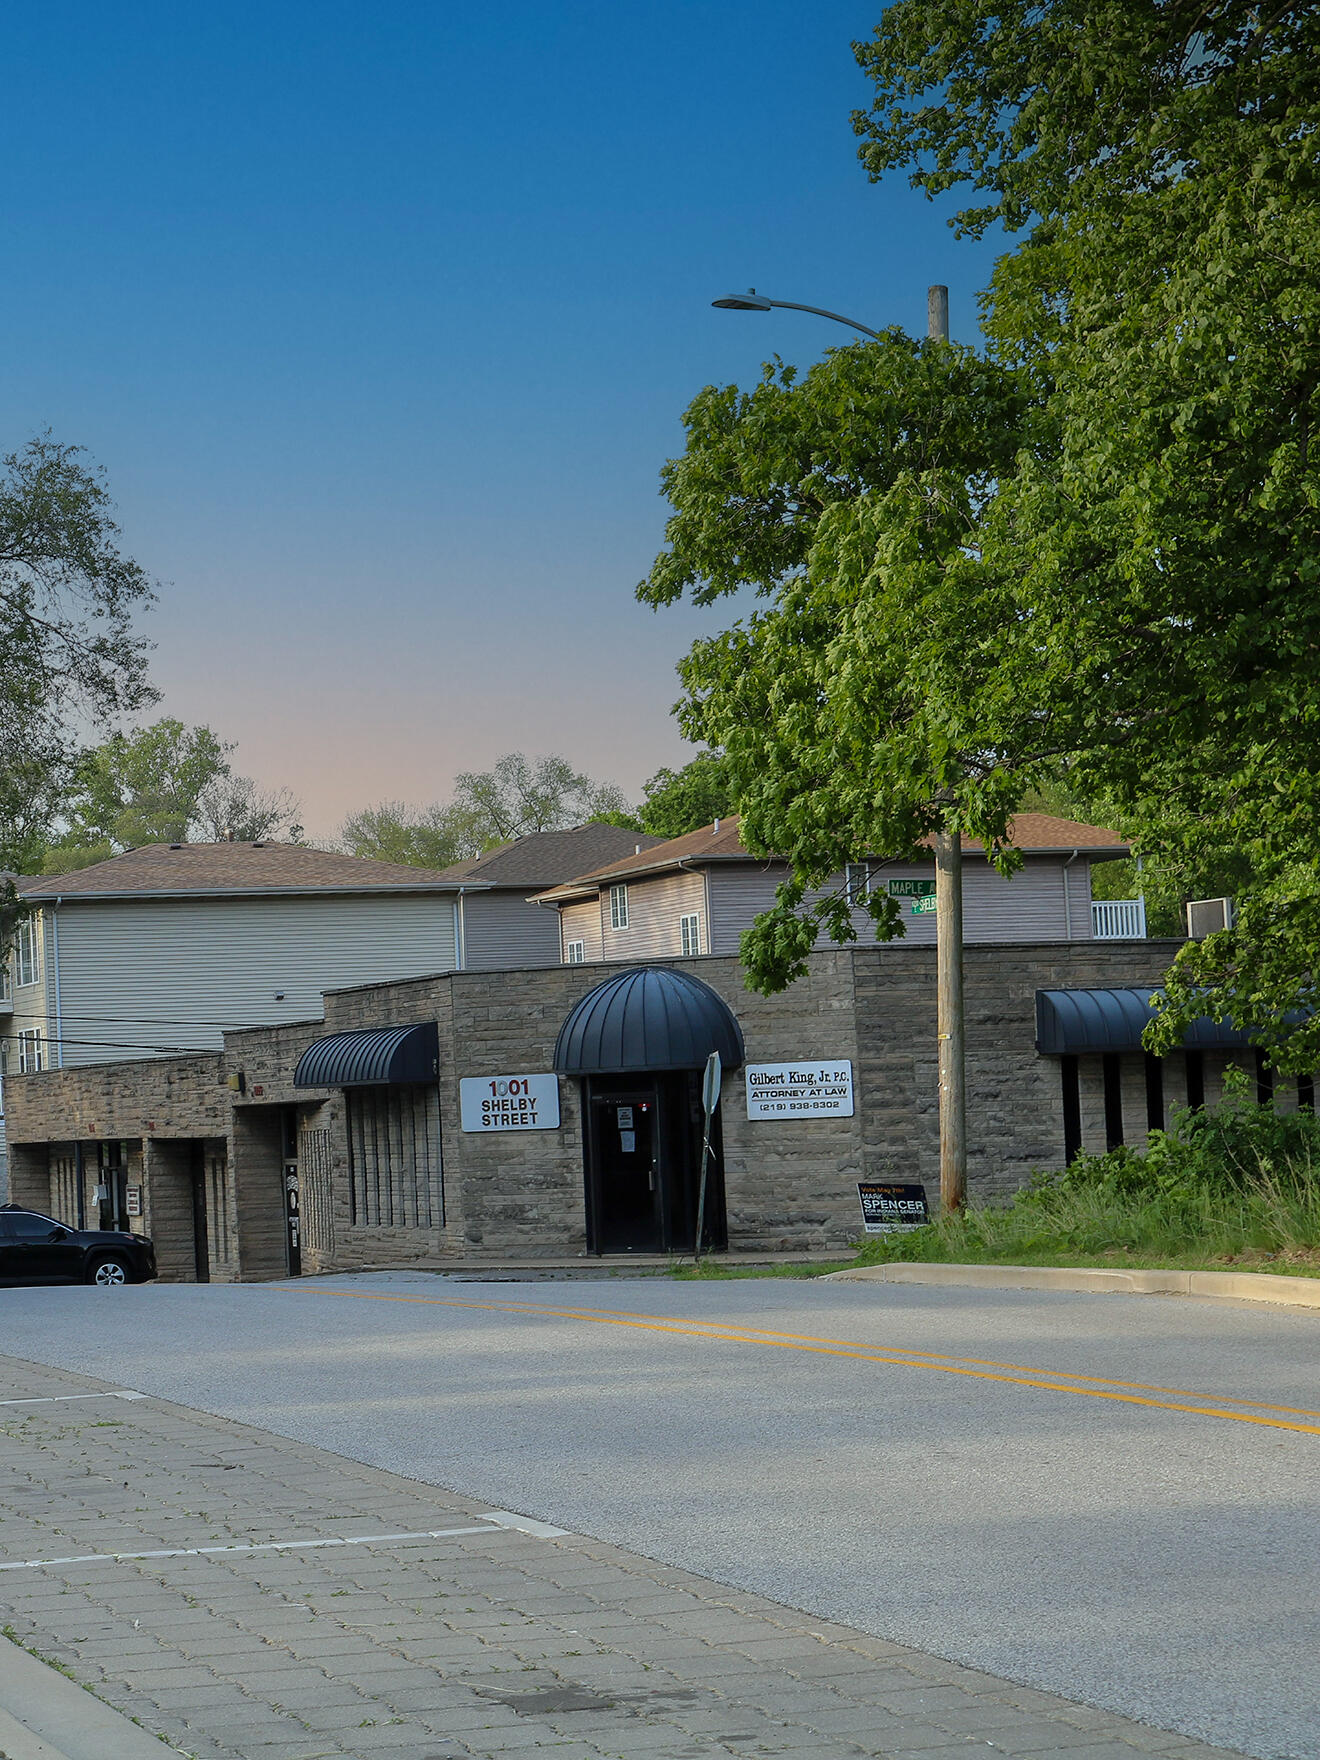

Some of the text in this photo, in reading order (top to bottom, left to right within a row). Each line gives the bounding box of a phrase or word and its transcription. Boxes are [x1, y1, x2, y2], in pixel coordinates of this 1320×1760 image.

[891, 882, 924, 894] MAPLE
[919, 897, 936, 912] SHELB
[749, 1072, 785, 1086] Gilbert
[788, 1071, 817, 1086] King,
[834, 1071, 850, 1082] P.C.
[488, 1079, 529, 1097] 1001
[751, 1087, 848, 1098] ATTORNEY AT LAW
[481, 1098, 537, 1112] SHELBY
[760, 1103, 786, 1112] (219)
[482, 1112, 538, 1126] STREET
[863, 1199, 924, 1210] SPENCER
